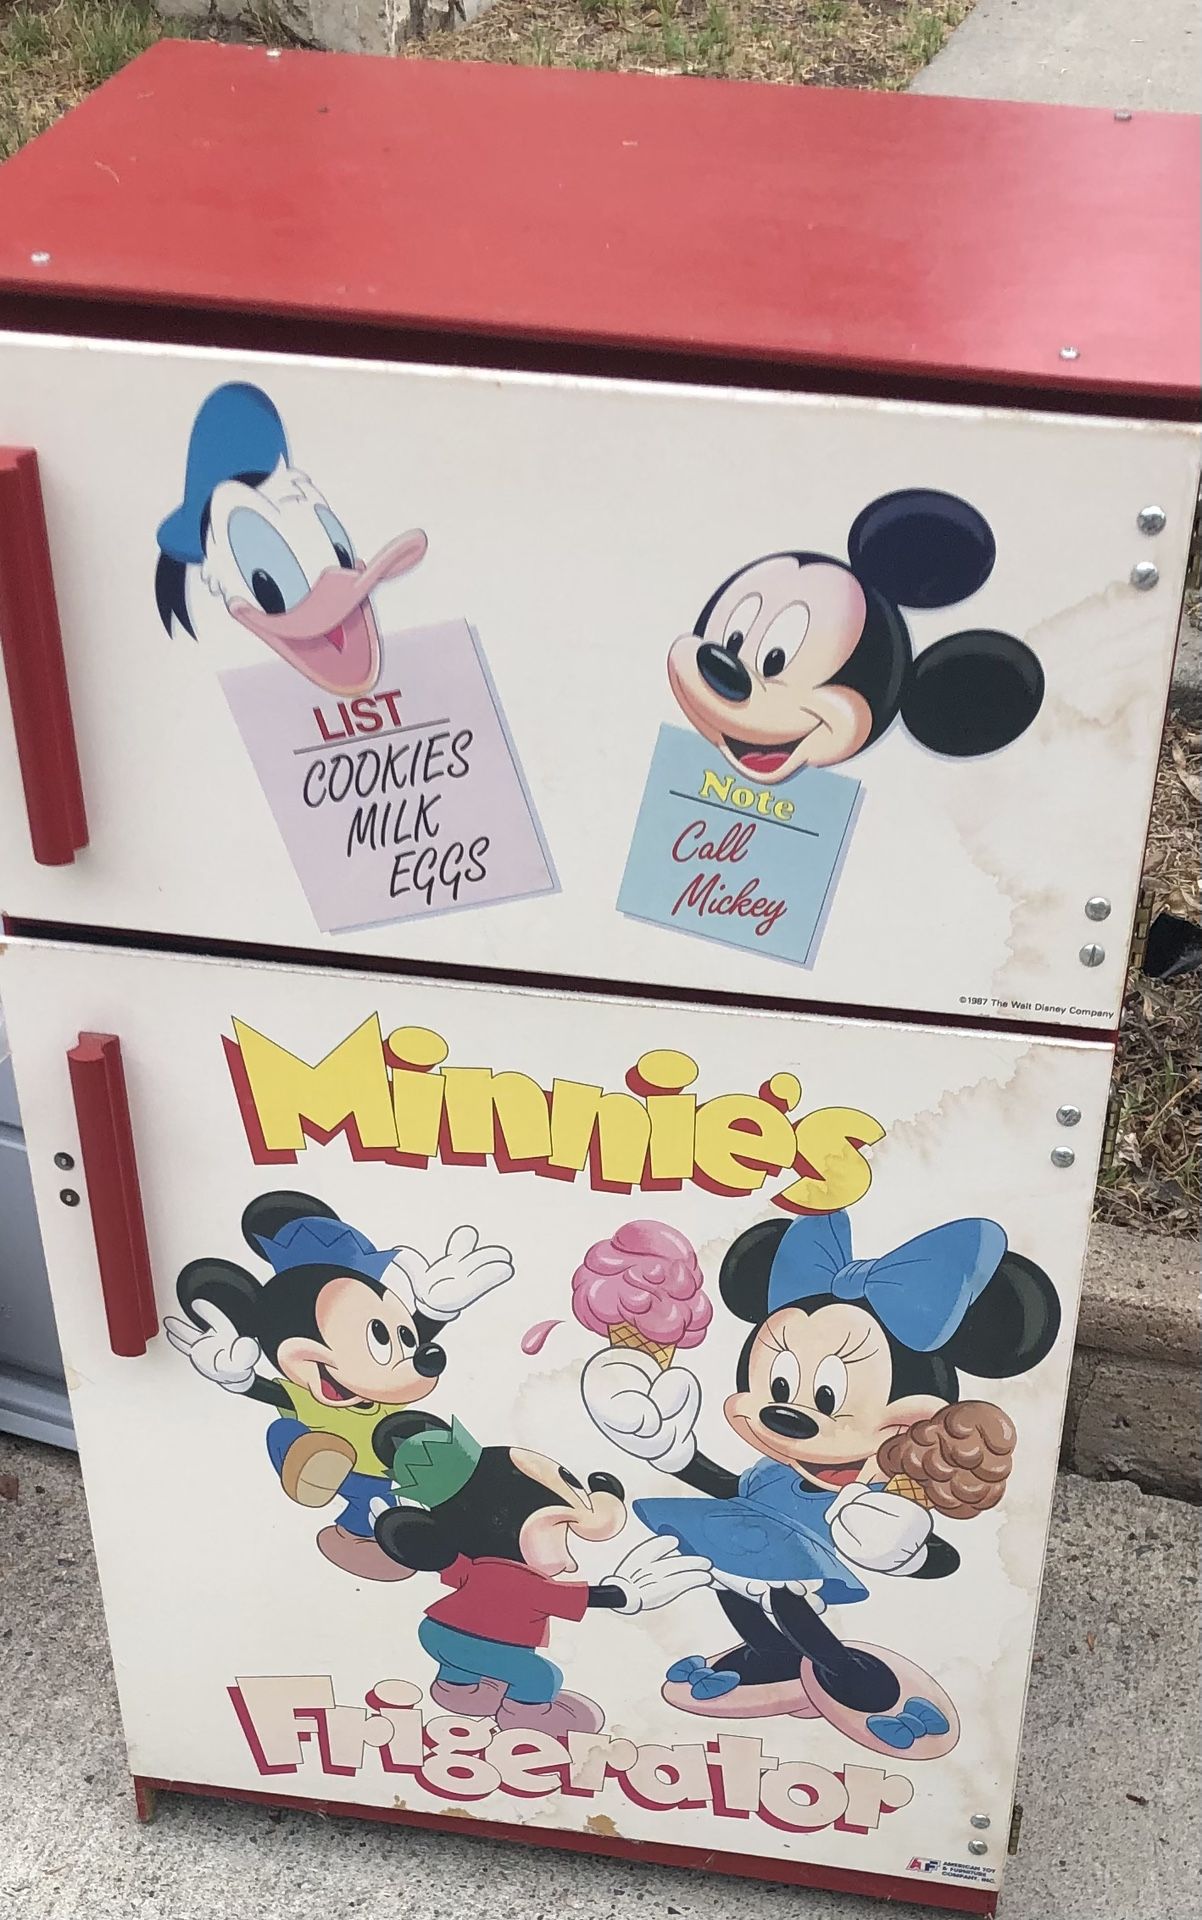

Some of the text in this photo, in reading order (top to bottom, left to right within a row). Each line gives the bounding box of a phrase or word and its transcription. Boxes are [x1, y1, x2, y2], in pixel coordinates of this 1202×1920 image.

[312, 689, 403, 742] LIST
[303, 729, 473, 808] COOKIES
[699, 769, 796, 821] Note
[346, 794, 442, 858] MILK
[671, 820, 757, 862] Call
[390, 836, 490, 905] EGGS
[671, 873, 788, 936] Mickey
[991, 999, 1008, 1009] The
[1011, 1001, 1032, 1011] Walt
[1035, 1003, 1067, 1015] Disney
[1069, 1007, 1115, 1020] Company
[222, 1011, 886, 1214] Minnie's
[227, 1675, 914, 1835] Frigerator
[943, 1861, 981, 1872] AMERICAN
[949, 1867, 987, 1877] FURNITURE
